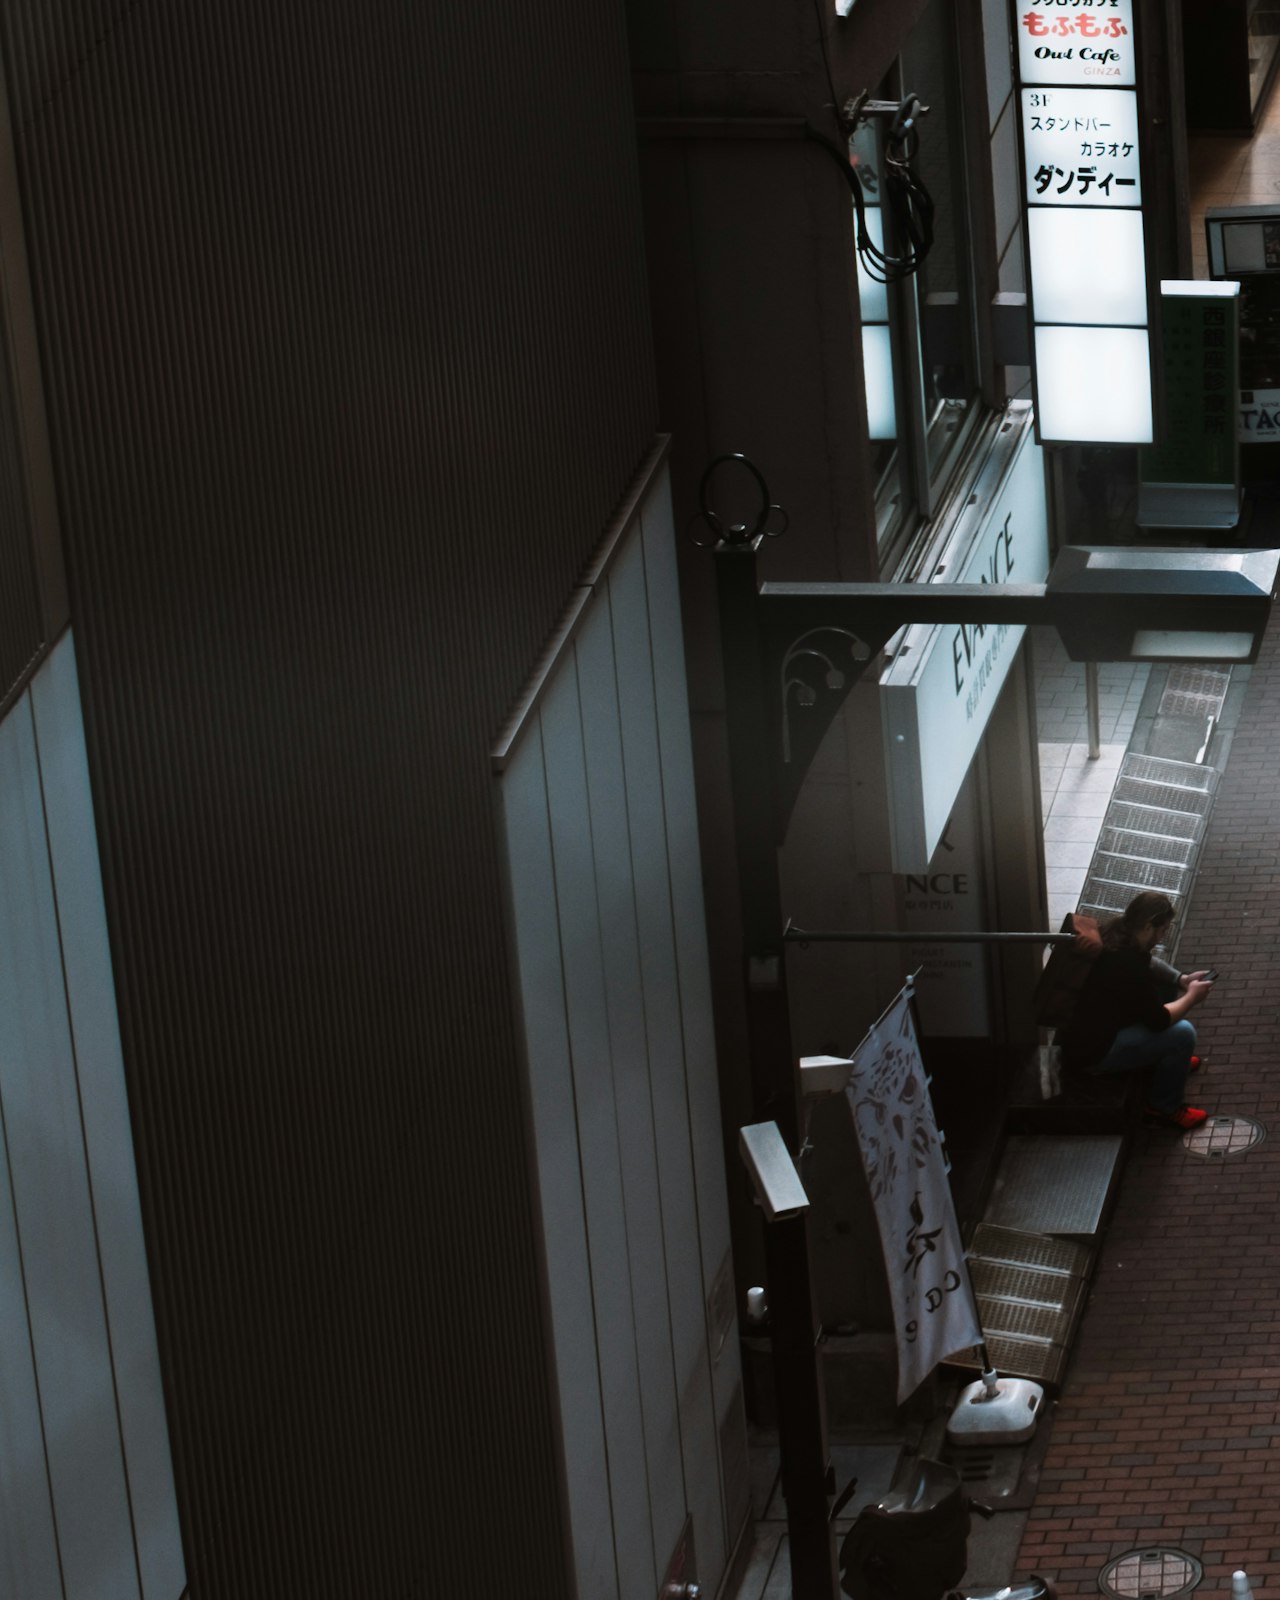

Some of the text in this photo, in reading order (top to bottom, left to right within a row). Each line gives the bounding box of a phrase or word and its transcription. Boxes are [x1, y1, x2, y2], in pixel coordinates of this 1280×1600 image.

[1022, 12, 1128, 38] もふもふ
[1034, 46, 1121, 65] Owl Cafe
[1083, 67, 1121, 76] GINZA
[1030, 94, 1052, 107] 3F
[1030, 116, 1111, 132] スタンドバー
[1080, 141, 1134, 158] カラオケ
[1033, 165, 1136, 197] ダンディー
